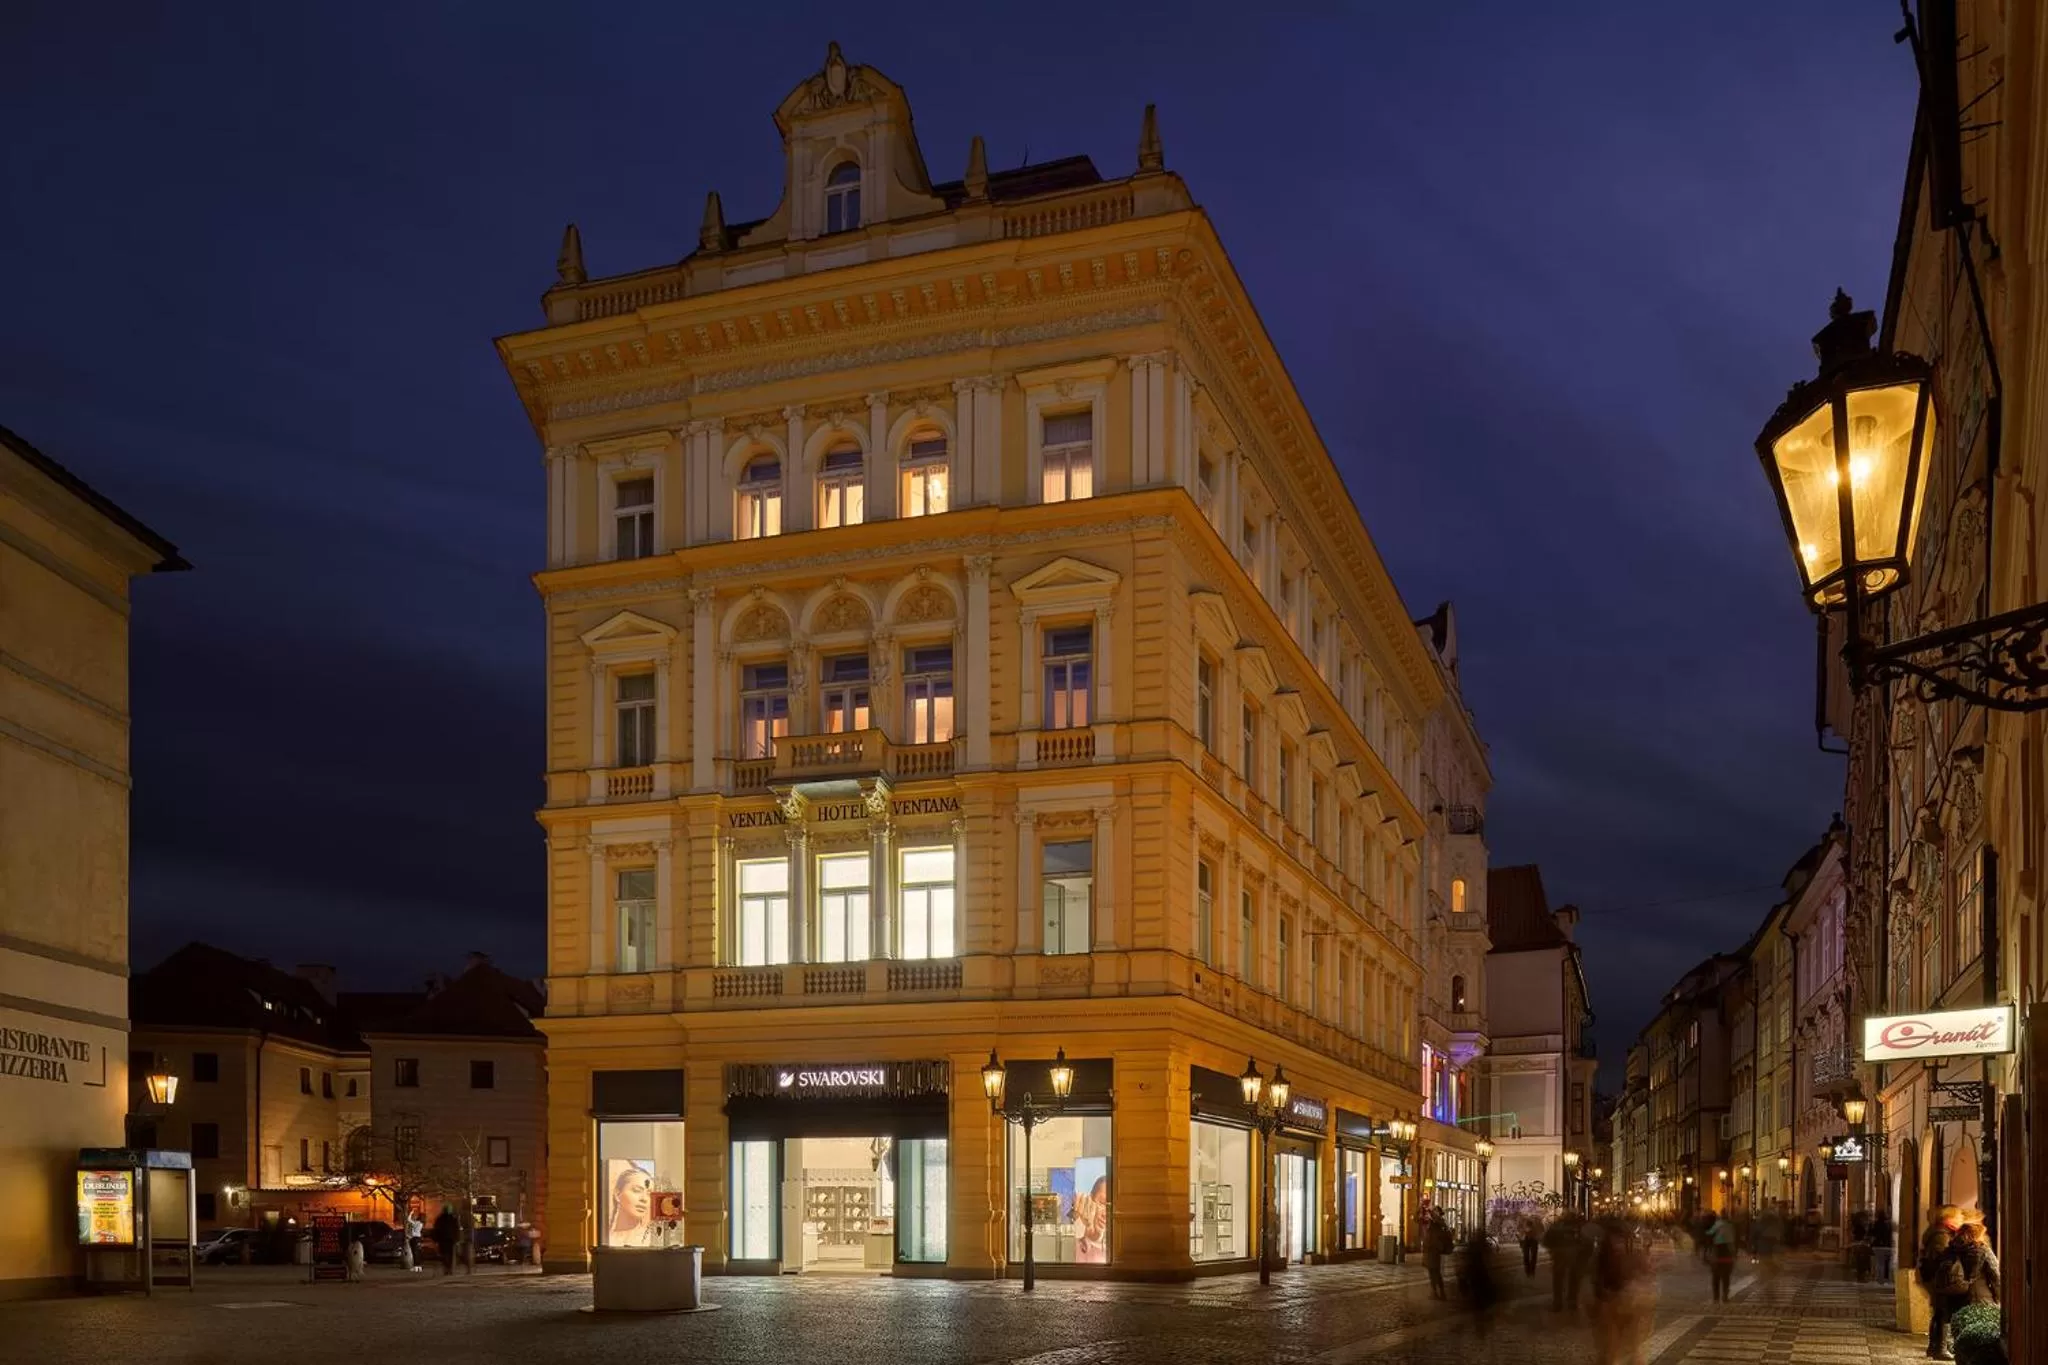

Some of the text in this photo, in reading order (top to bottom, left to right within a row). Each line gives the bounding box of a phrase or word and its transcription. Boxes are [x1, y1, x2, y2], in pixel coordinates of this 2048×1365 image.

[728, 797, 960, 828] VENTAN HOTEL VENTANA
[0, 1027, 90, 1062] ISTORANTE
[0, 1053, 68, 1083] IZZERIA
[799, 1070, 884, 1086] SWAROVSKI
